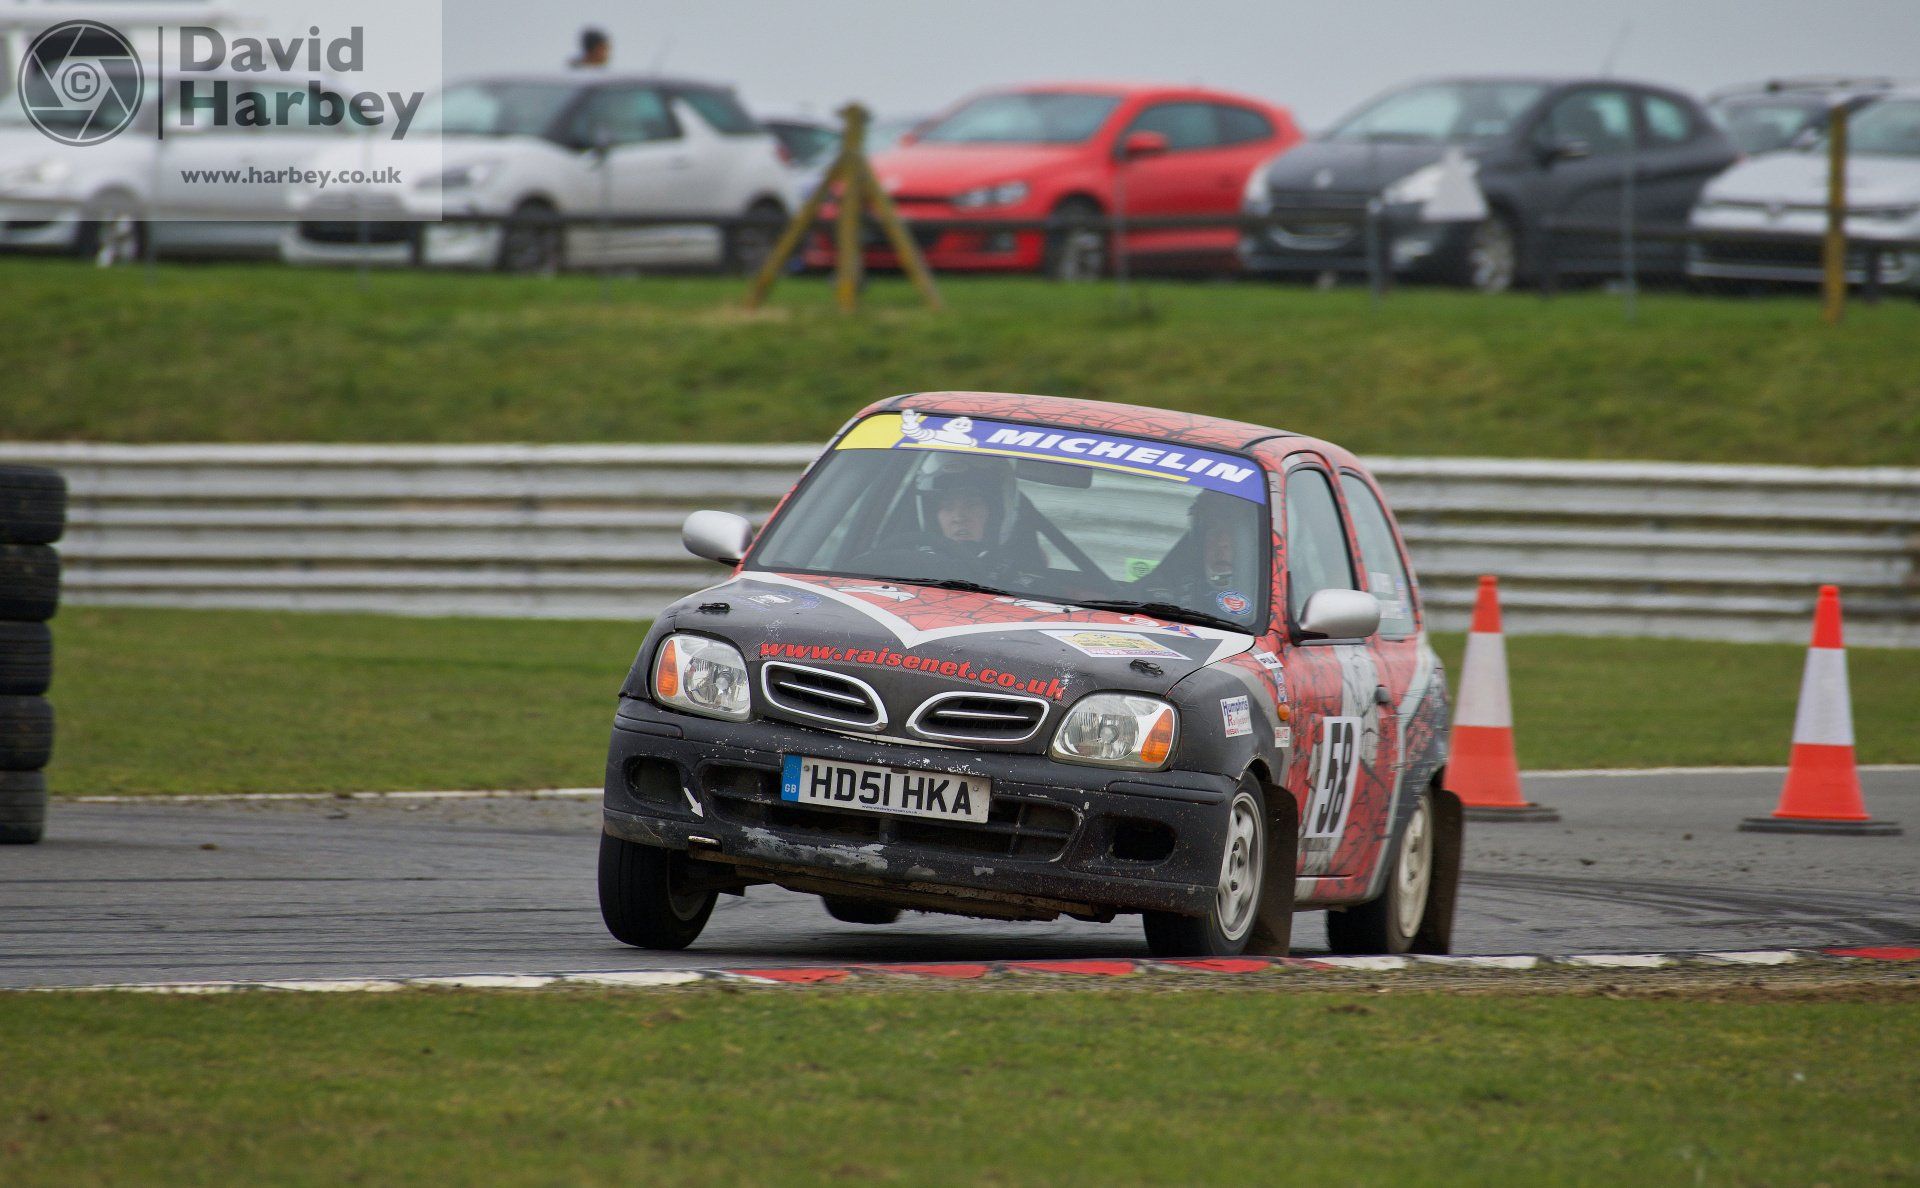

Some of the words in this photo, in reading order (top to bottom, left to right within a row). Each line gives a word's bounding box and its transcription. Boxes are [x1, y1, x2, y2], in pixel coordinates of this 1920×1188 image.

[985, 428, 1255, 483] MICHELIN
[760, 643, 1066, 701] www.raisenet.co.uk
[784, 783, 797, 793] GB
[810, 764, 891, 806] HD51
[902, 775, 972, 815] HKA
[1316, 722, 1353, 834] 58
